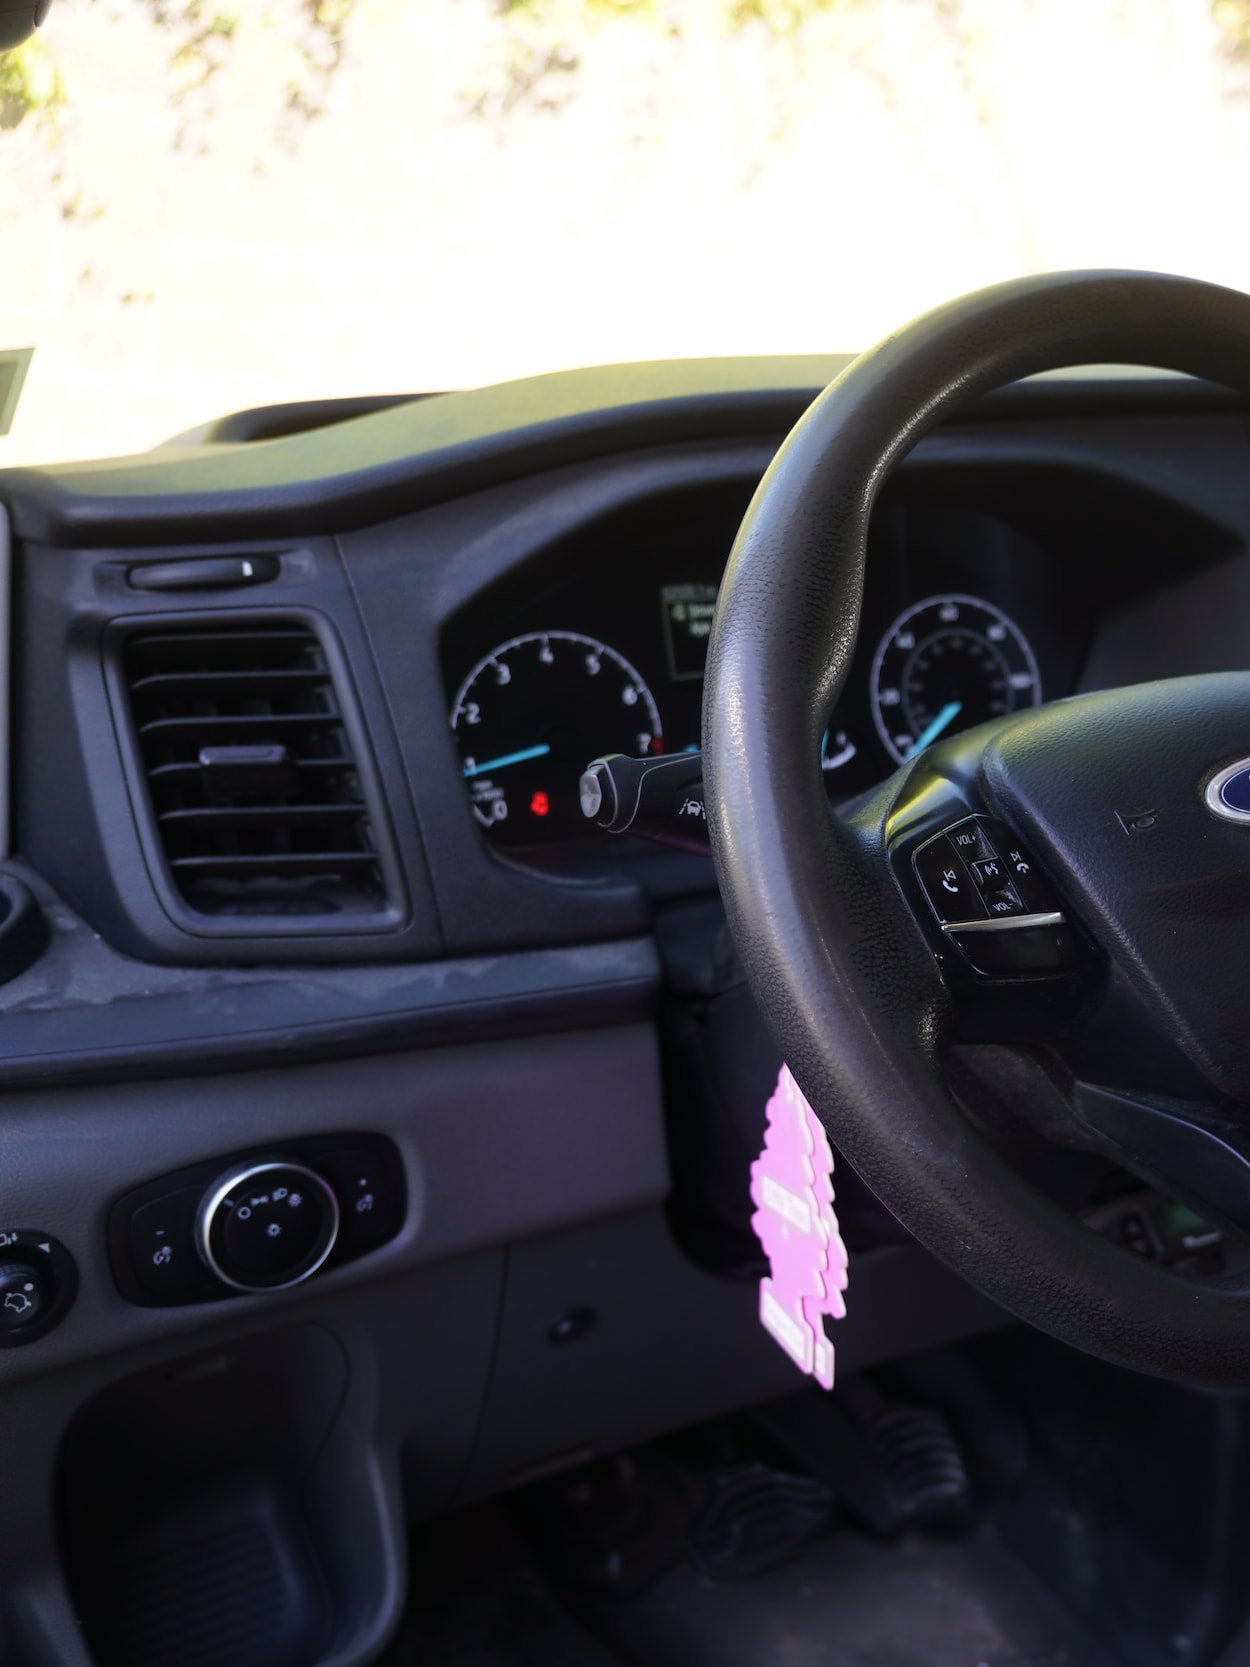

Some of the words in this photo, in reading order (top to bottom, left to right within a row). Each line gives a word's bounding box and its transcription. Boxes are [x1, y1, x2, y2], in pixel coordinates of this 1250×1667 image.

[498, 662, 512, 685] 3
[586, 655, 600, 675] 5
[622, 685, 638, 706] 6
[465, 702, 481, 724] 2
